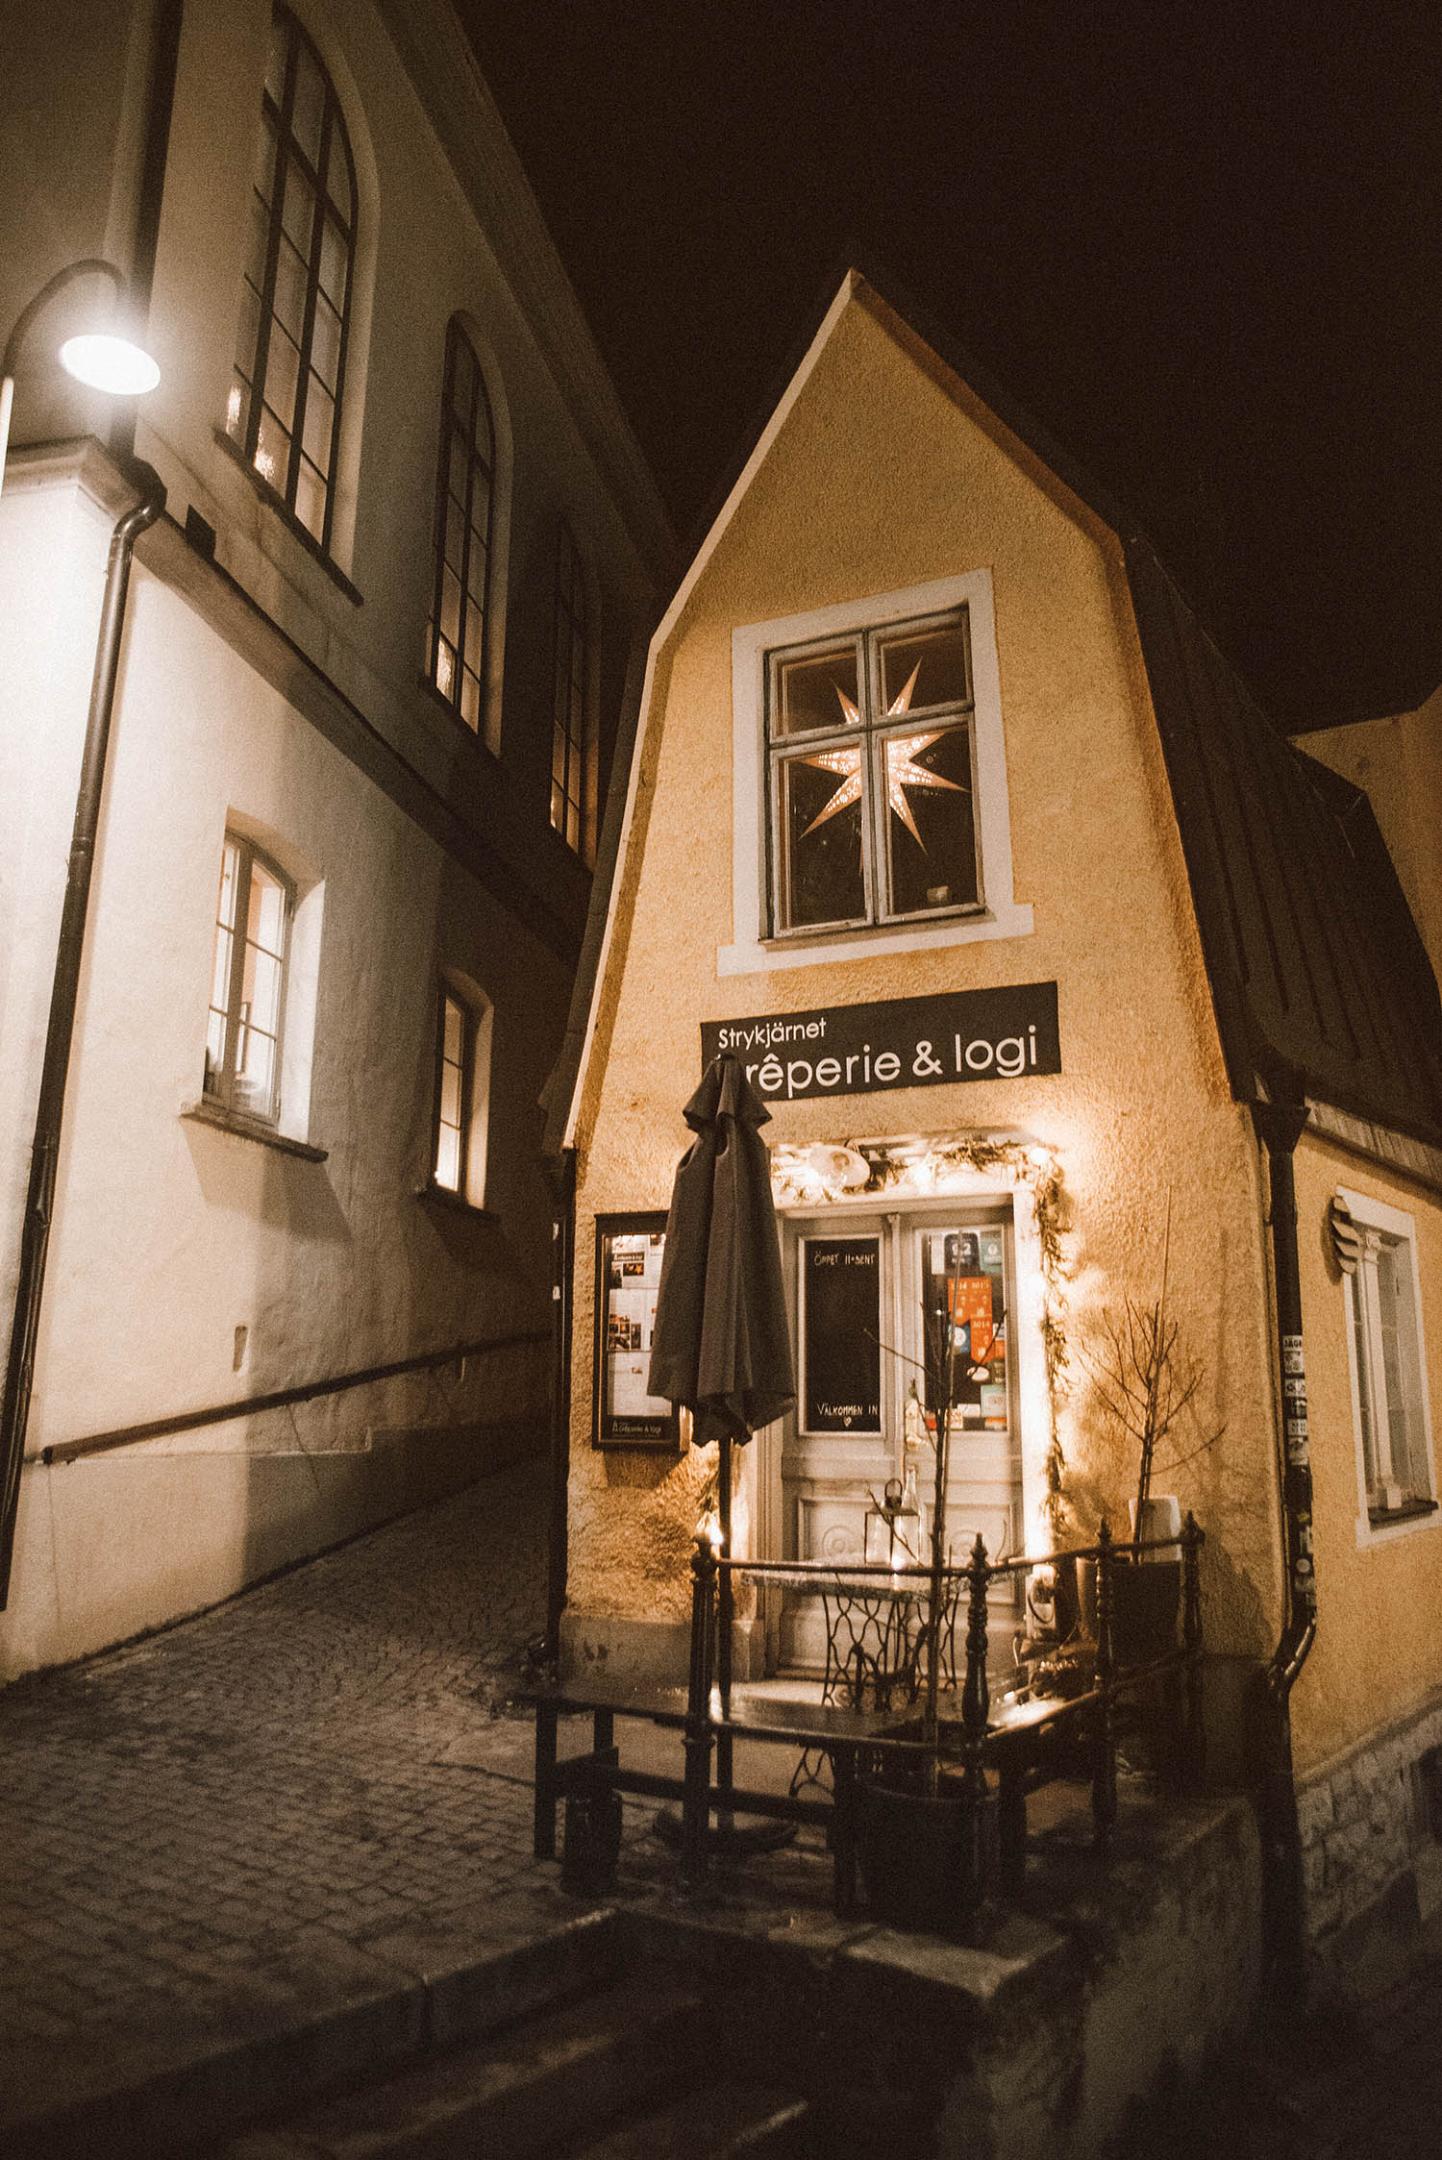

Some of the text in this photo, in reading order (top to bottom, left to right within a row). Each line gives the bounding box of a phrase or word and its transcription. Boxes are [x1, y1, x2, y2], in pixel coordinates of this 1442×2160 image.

[718, 1017, 827, 1050] Strykjärnet
[745, 1025, 1038, 1099] rêperie & logi
[816, 1402, 878, 1416] VÄLKOMMEN IN
